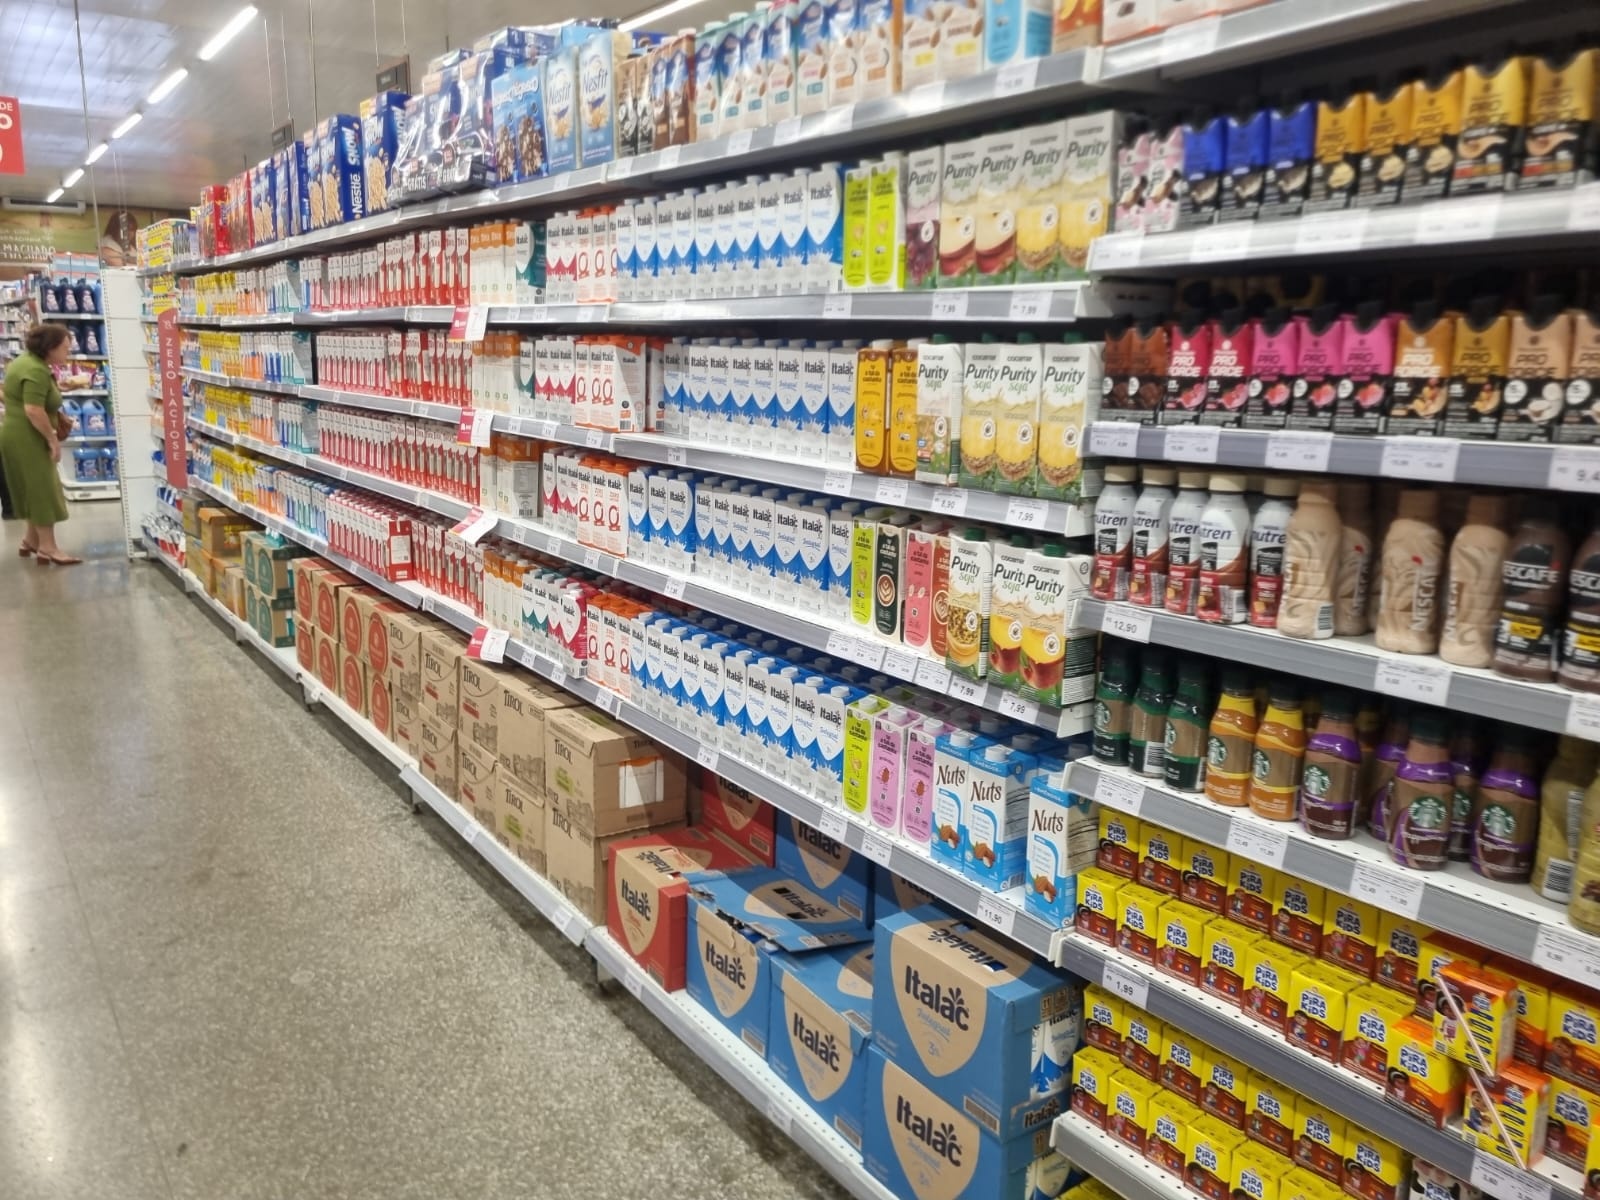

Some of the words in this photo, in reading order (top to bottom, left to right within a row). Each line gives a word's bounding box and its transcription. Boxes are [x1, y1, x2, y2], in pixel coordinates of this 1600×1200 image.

[583, 66, 608, 91] Nesfit
[1023, 150, 1061, 167] Purity
[1067, 139, 1108, 159] Purity
[945, 162, 979, 181] Purity
[980, 156, 1018, 173] Purity
[909, 171, 937, 186] Purity
[350, 174, 363, 214] Nestlé
[165, 338, 177, 380] ZERO
[919, 364, 949, 381] Purity
[966, 364, 1000, 383] Purity
[1000, 365, 1037, 384] Purity
[1045, 366, 1085, 385] Purity
[169, 388, 180, 460] LACTOSE
[1018, 512, 1034, 522] 7,99
[1096, 513, 1128, 527] utren
[1252, 530, 1287, 544] nutre
[952, 555, 981, 576] Purity
[1026, 574, 1064, 598] Purity
[1034, 589, 1056, 604] soja
[1114, 620, 1137, 634] 12,90
[960, 685, 974, 697] 7,99
[1010, 703, 1025, 714] 7,99
[936, 764, 966, 787] Nuts
[971, 781, 1002, 803] Nuts
[1032, 809, 1064, 832] Nuts
[621, 879, 651, 922] Italac
[706, 940, 746, 990] Italac
[1116, 981, 1134, 996] 1,99
[905, 966, 970, 1032] Italac
[794, 1013, 840, 1073] Italac
[896, 1096, 961, 1167] Italac
